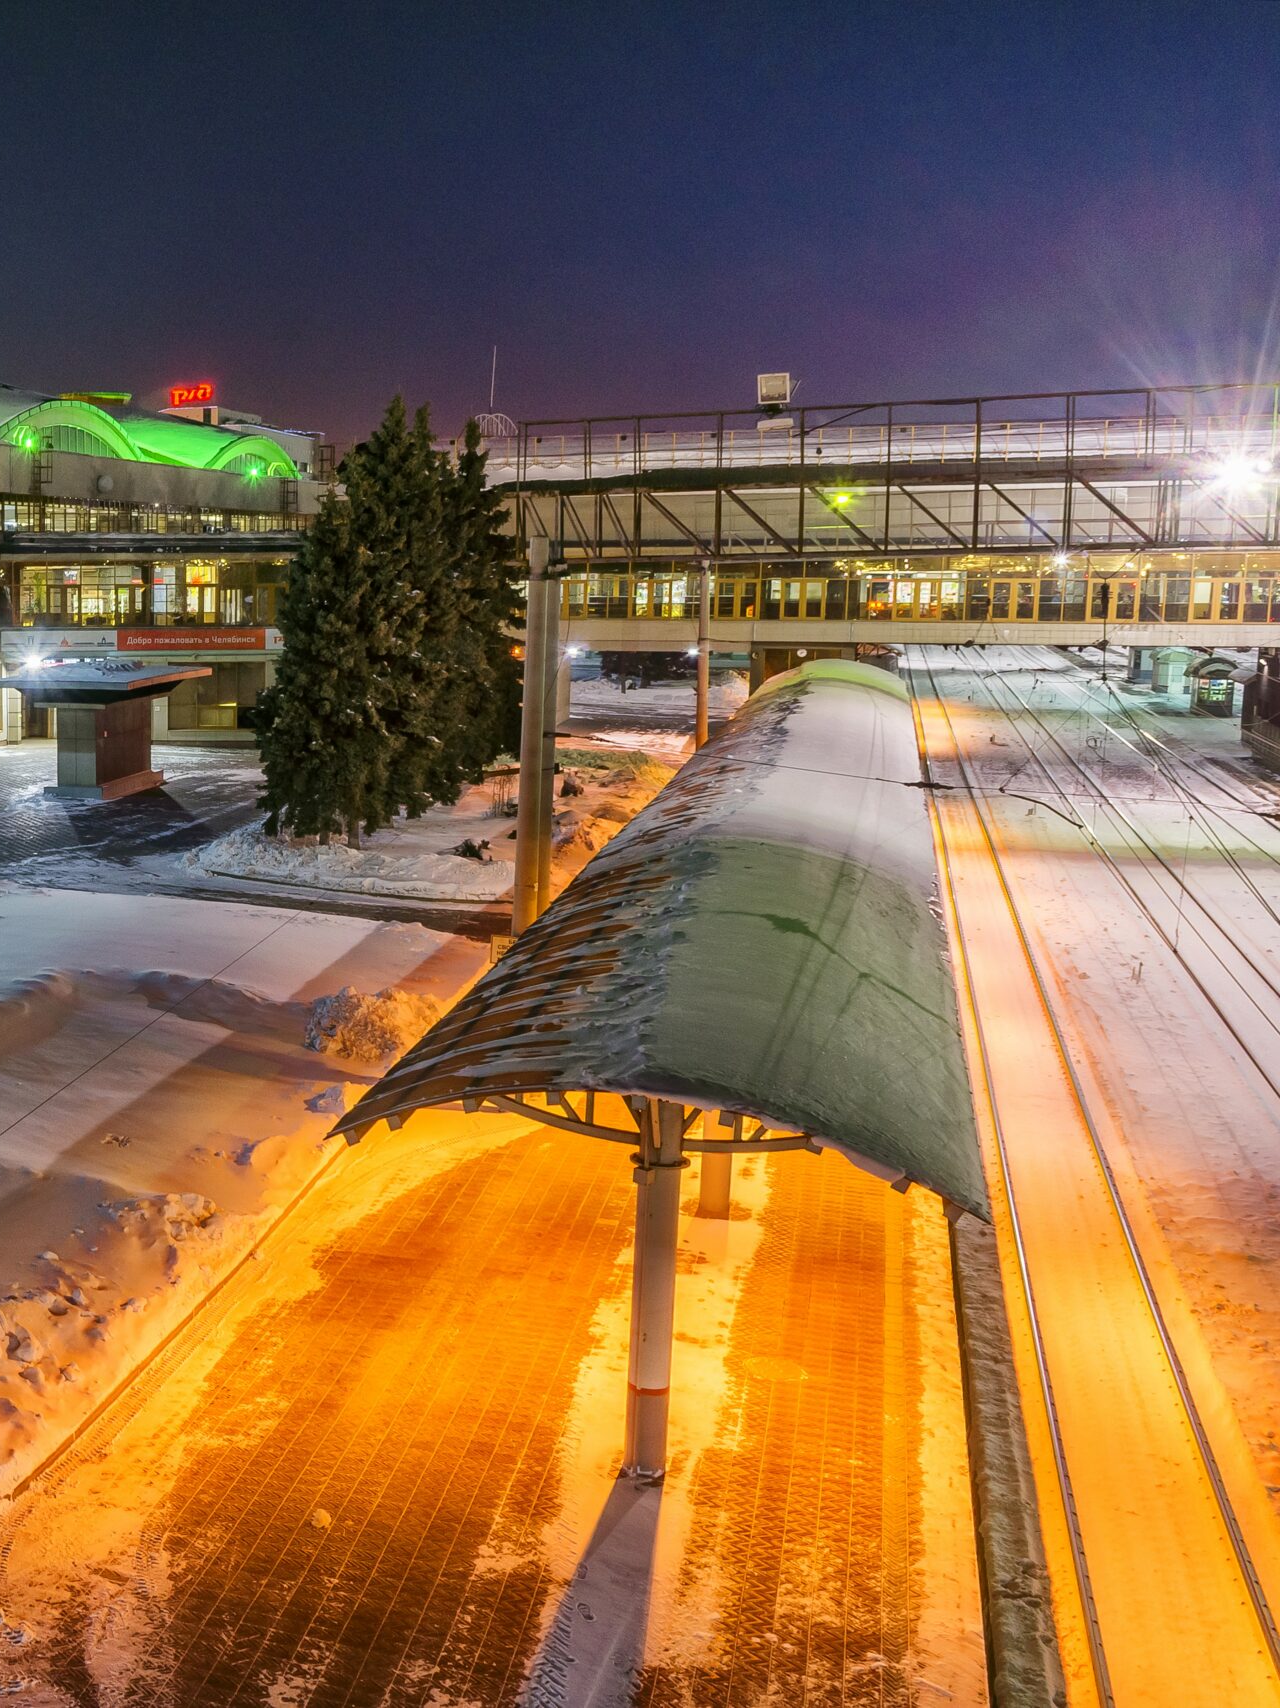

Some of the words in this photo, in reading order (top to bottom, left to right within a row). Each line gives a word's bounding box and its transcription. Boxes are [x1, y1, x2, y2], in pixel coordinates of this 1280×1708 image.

[126, 636, 152, 646] Добро
[154, 636, 202, 645] пожаловать
[211, 635, 257, 645] Челябинск
